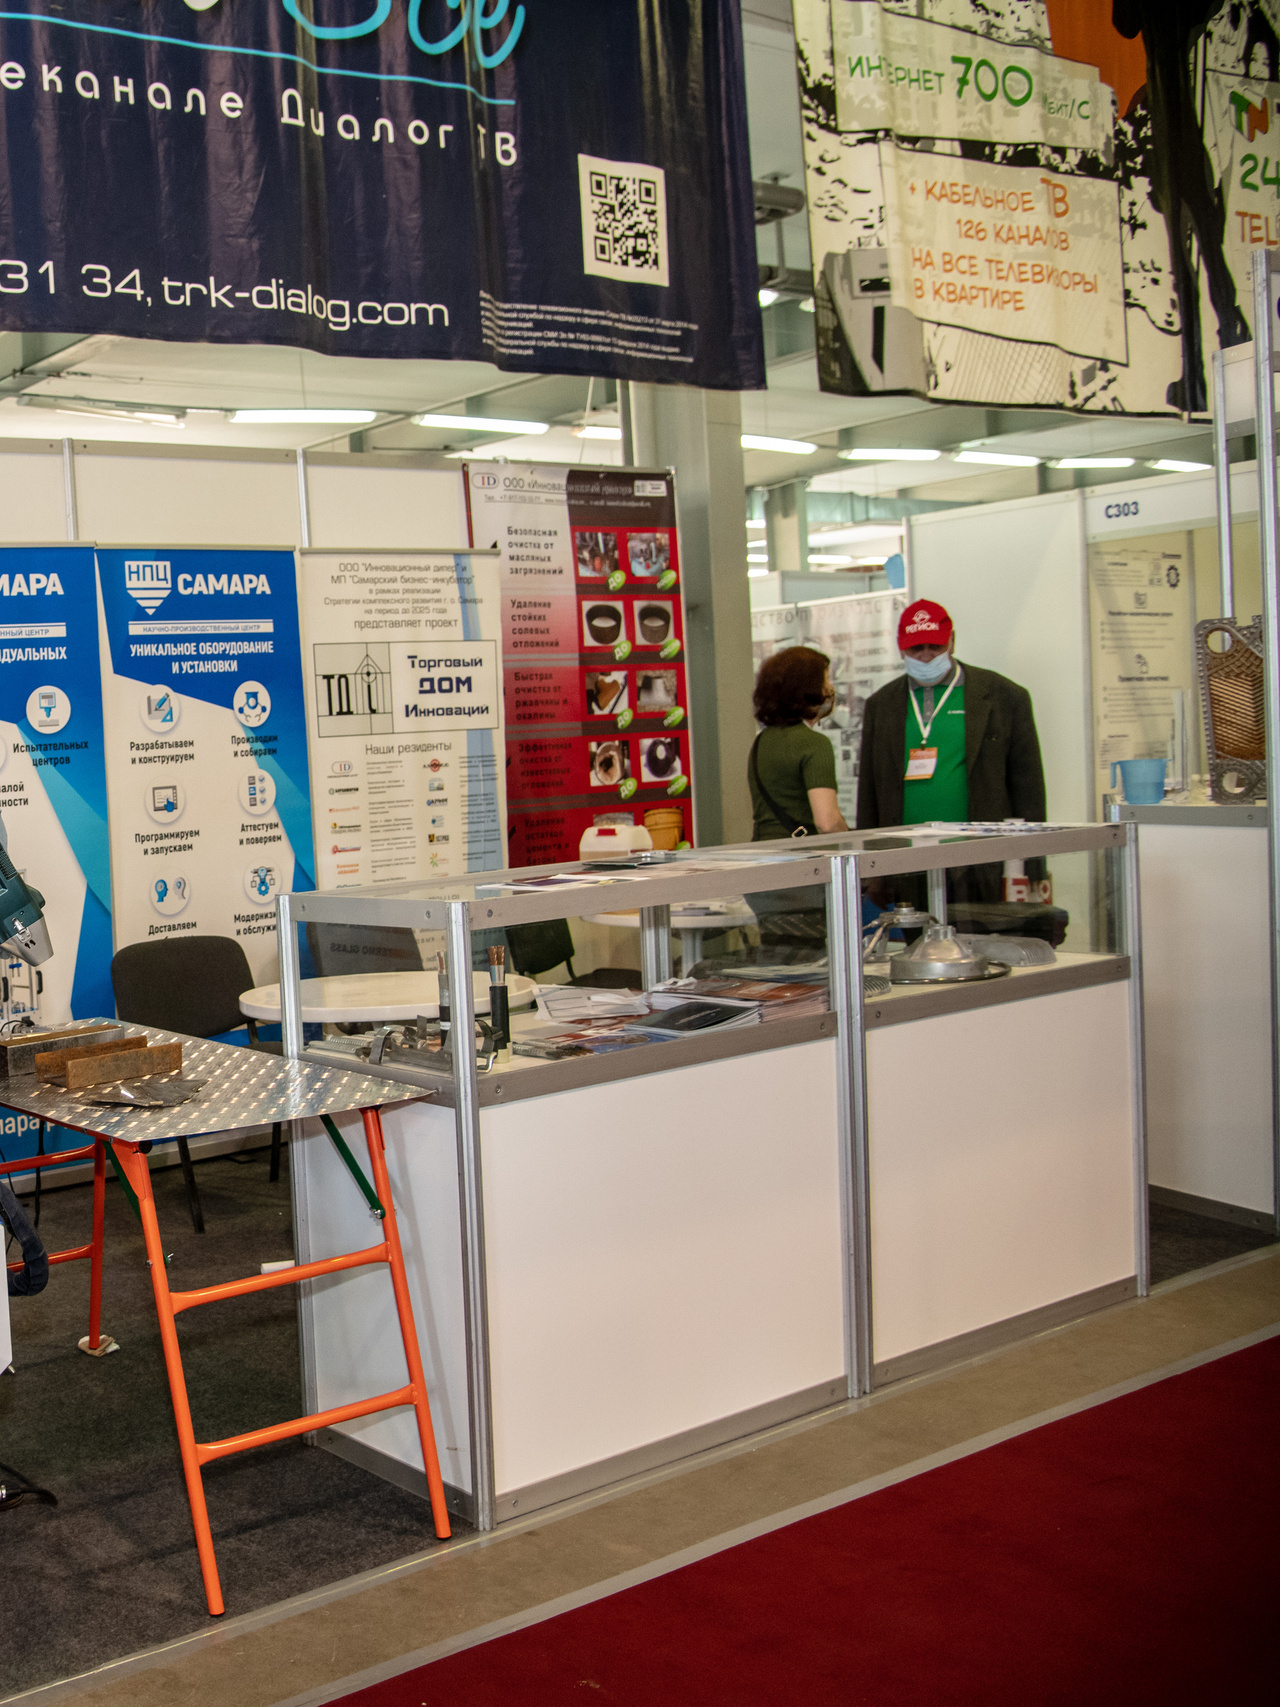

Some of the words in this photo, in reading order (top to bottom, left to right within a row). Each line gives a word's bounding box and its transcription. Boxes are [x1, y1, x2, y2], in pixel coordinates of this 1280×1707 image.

[848, 56, 945, 94] ИНЕРНЕТ
[951, 55, 1033, 107] 700
[281, 88, 453, 149] Диалог
[925, 179, 1035, 212] КАБЕЛЬНОЕ
[1040, 177, 1070, 218] ТВ
[956, 218, 988, 242] 126
[911, 247, 936, 271] НА
[942, 252, 980, 276] ВСЕ
[81, 264, 153, 307] 34,
[162, 275, 451, 332] trk-dialog.com
[913, 278, 925, 299] В
[932, 280, 1025, 312] КВАРТИРЕ
[507, 526, 558, 537] Безопасная
[508, 541, 541, 551] очистка
[543, 541, 554, 550] от
[509, 554, 552, 563] масляных
[339, 563, 359, 572] ООО
[509, 566, 564, 576] загрязнений
[128, 564, 169, 584] НПЦ
[331, 575, 346, 584] МП
[177, 573, 271, 595] САМАРА
[375, 588, 400, 596] рамках
[324, 598, 361, 607] Стратегии
[511, 599, 552, 610] Удаление
[511, 612, 547, 622] стойких
[143, 624, 239, 633] НАУЧНО-ПРОИЗВОДСТВЕННЫЙ
[241, 624, 261, 632] ЦЕНТР
[354, 620, 421, 630] представляет
[425, 619, 458, 630] проект
[25, 628, 49, 637] ЦЕНТР
[512, 626, 550, 635] солевых
[130, 642, 197, 657] УНИКАЛЬНОЕ
[199, 640, 274, 656] ОБОРУДОВАНИЕ
[513, 639, 560, 649] отложений
[172, 662, 180, 674] И
[181, 659, 238, 673] УСТАНОВКИ
[407, 655, 482, 672] Торговый
[514, 672, 554, 682] Быстрая
[419, 676, 472, 694] ДОМ
[515, 685, 551, 695] очистка
[553, 685, 562, 694] от
[405, 704, 489, 718] Инноваций
[516, 711, 556, 721] окалины
[231, 734, 278, 745] Производим
[13, 741, 89, 753] Испытательных
[130, 739, 194, 752] Разрабатываем
[365, 743, 394, 755] Наши
[398, 742, 452, 756] резиденты
[240, 747, 277, 757] собираем
[32, 756, 70, 767] центров
[138, 753, 195, 765] конструируем
[240, 822, 279, 833] Аттестуем
[135, 829, 200, 844] Программируем
[246, 834, 282, 845] поверяем
[150, 843, 193, 855] запускаем
[148, 920, 197, 936] Доставляем
[236, 928, 241, 936] и
